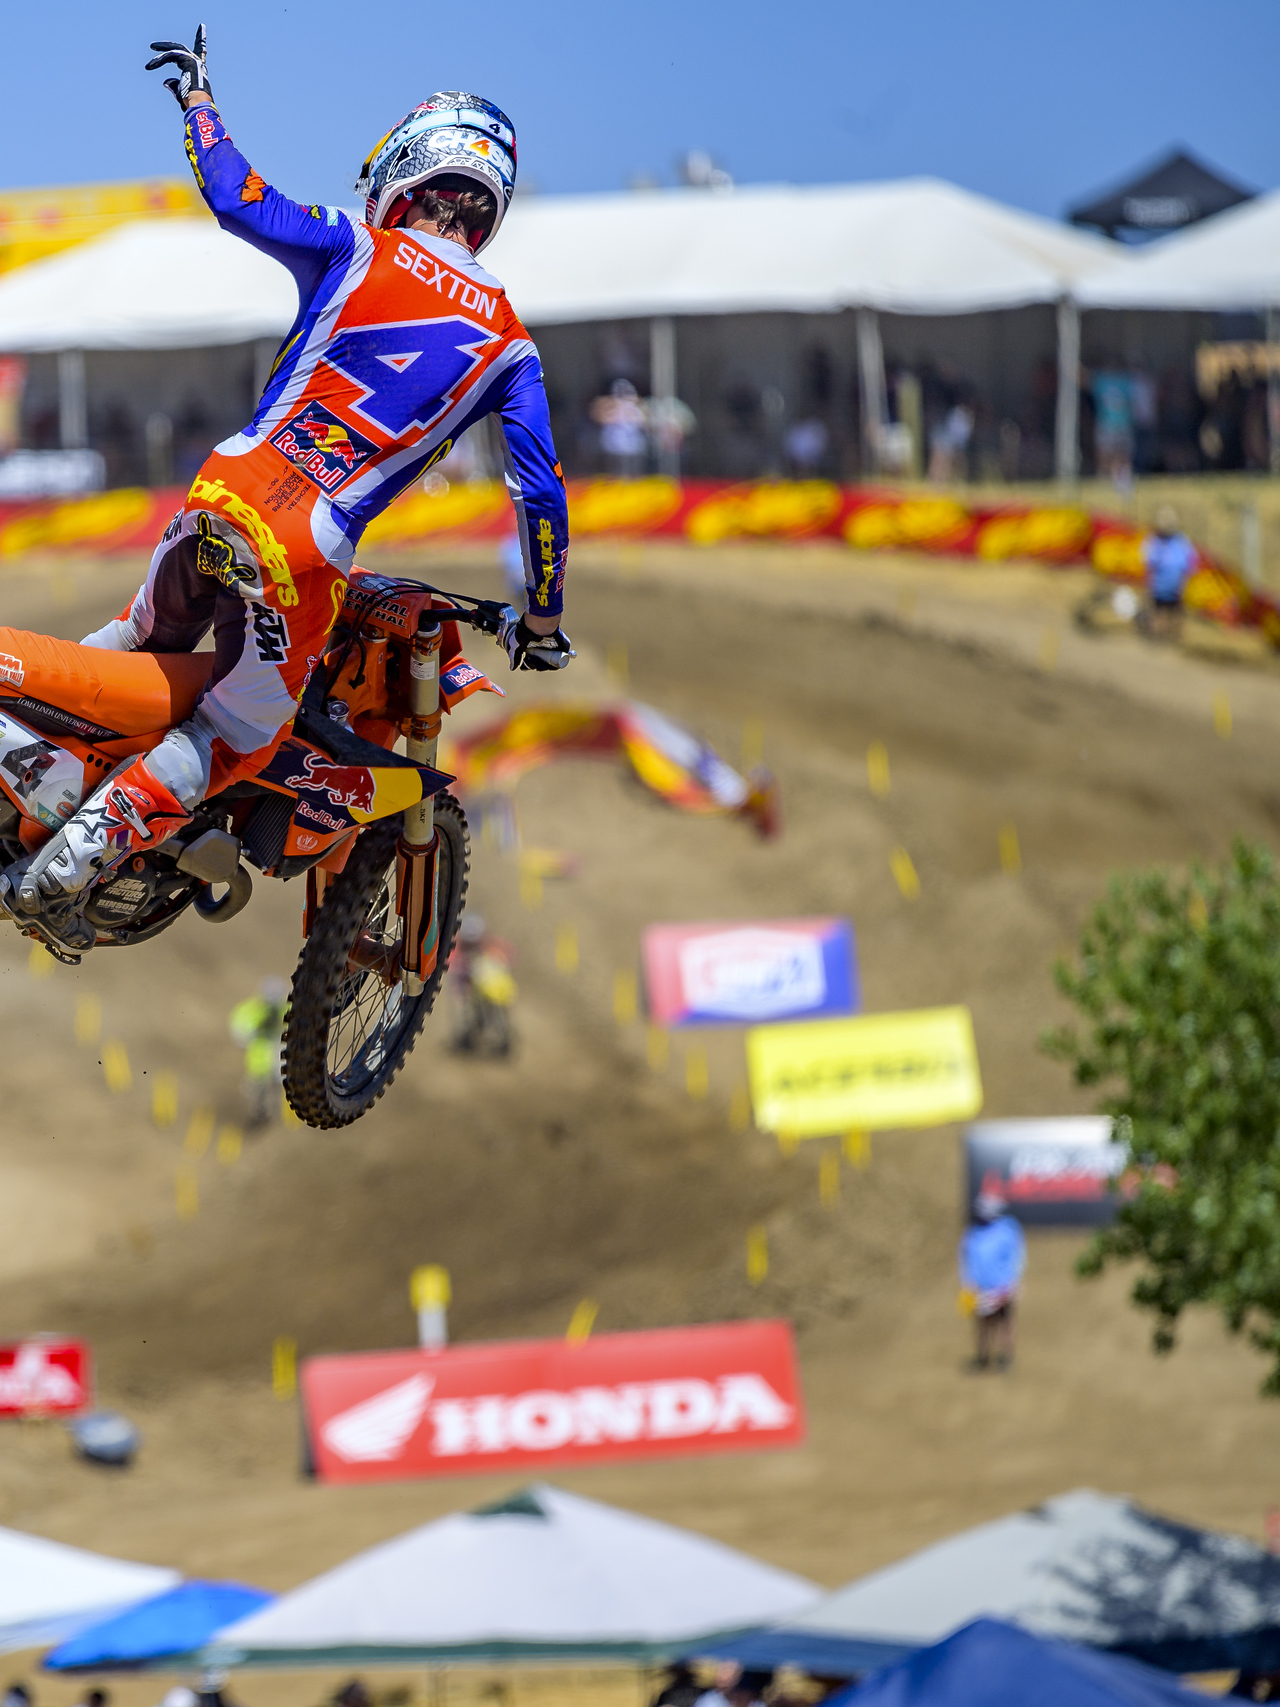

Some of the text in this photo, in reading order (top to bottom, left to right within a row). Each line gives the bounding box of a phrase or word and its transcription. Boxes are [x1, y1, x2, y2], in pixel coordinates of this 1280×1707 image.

[488, 123, 501, 135] 4
[393, 242, 497, 320] SEXTON
[321, 315, 503, 440] 4
[188, 474, 299, 607] lpinestars
[251, 602, 288, 662] KTM
[343, 600, 407, 629] ENTHAL
[35, 704, 54, 717] LINDA
[54, 711, 89, 731] UNIVERSITY
[0, 740, 62, 799] 4
[104, 886, 146, 899] FACTORY
[113, 878, 147, 892] KTM
[428, 1372, 796, 1458] HONDA
